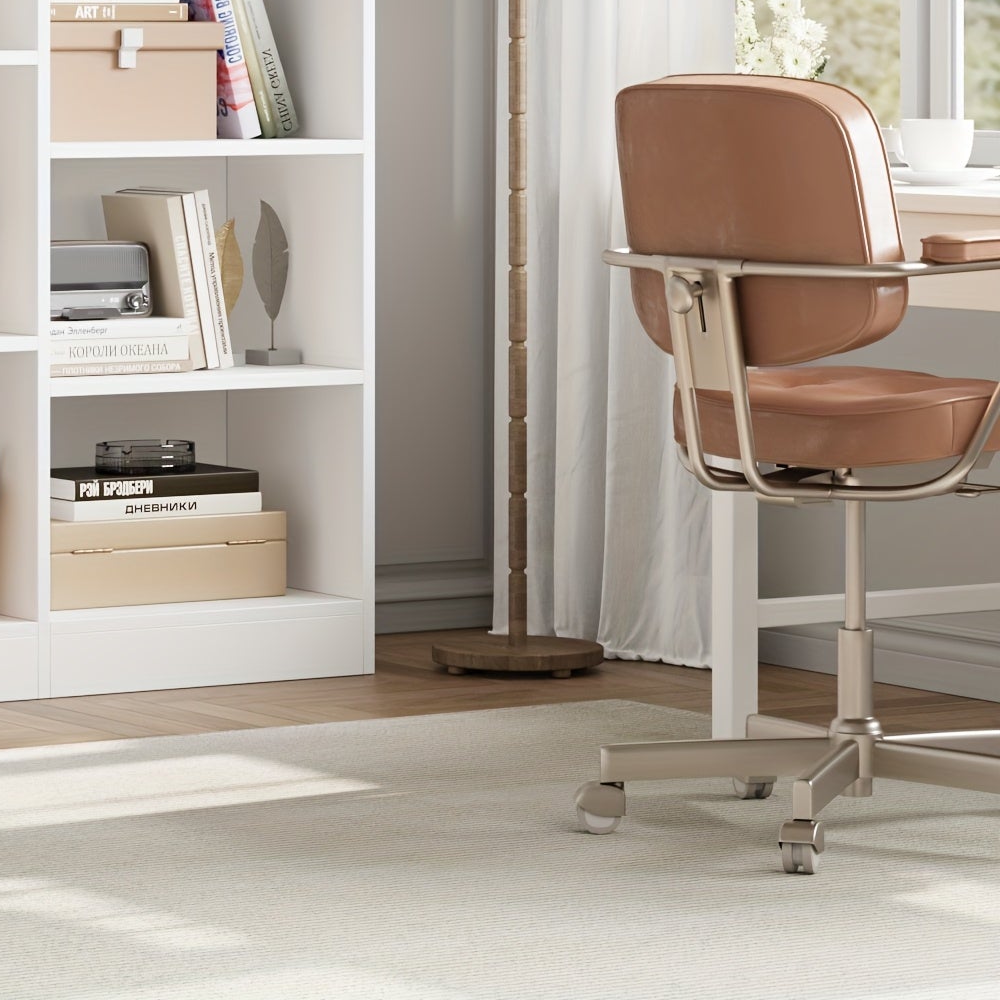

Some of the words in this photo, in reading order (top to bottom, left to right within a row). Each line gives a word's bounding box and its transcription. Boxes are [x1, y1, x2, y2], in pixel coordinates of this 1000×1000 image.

[74, 5, 99, 19] ART
[67, 326, 109, 336] Элленберг
[68, 344, 118, 359] КОРОЛИ
[119, 343, 169, 356] ОКЕАНА
[78, 479, 100, 498] РЭЙ
[103, 480, 154, 497] БРЭДБЕРИ
[124, 501, 198, 515] ДНЕВНИКИ
